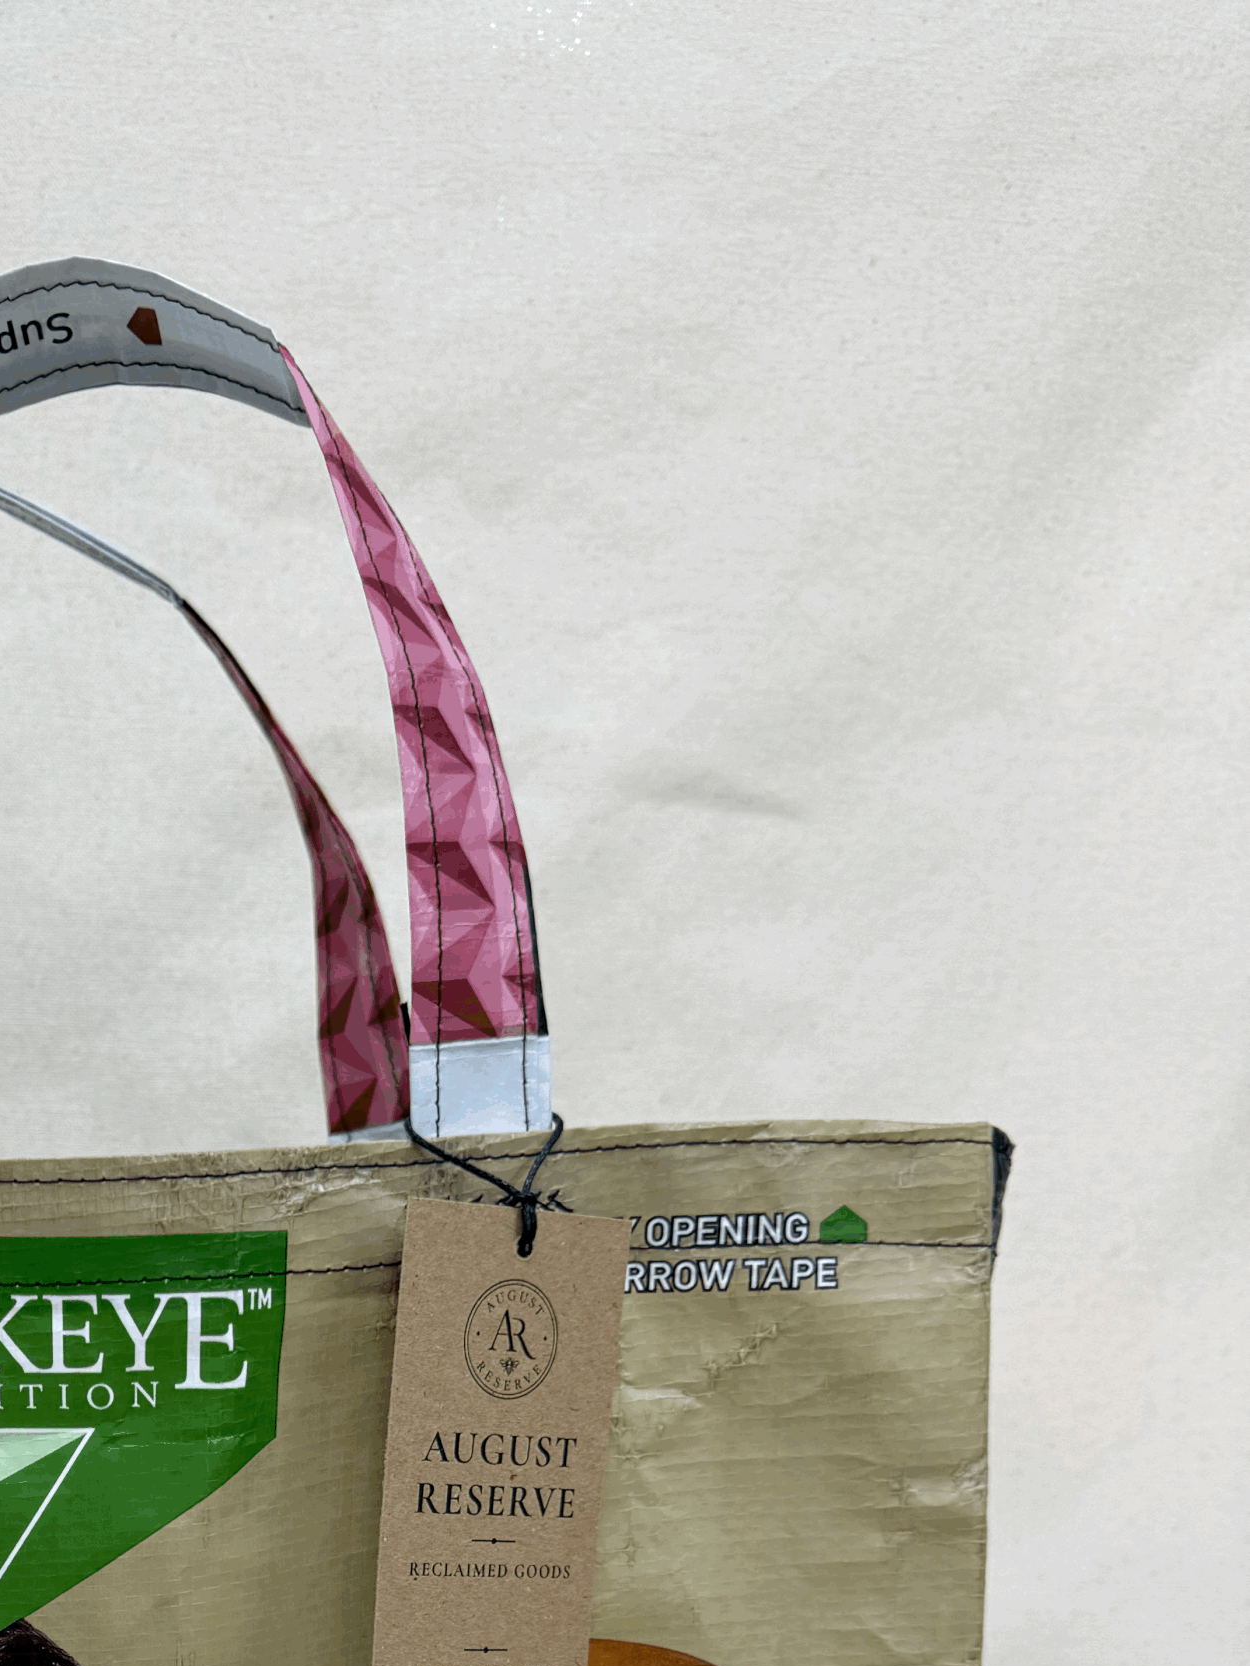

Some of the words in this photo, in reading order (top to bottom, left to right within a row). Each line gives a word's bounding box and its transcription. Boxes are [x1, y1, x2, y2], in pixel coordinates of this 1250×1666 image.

[645, 1212, 810, 1248] OPENING
[624, 1257, 737, 1294] RROW
[742, 1255, 839, 1292] TAPE
[486, 1289, 545, 1316] AUGUST
[488, 1308, 537, 1360] AR
[476, 1360, 543, 1391] RESERVE
[421, 1431, 578, 1468] AUGUST
[414, 1482, 576, 1518] RESERVE
[409, 1562, 508, 1578] RECLAIMED
[514, 1564, 571, 1579] GOODS
